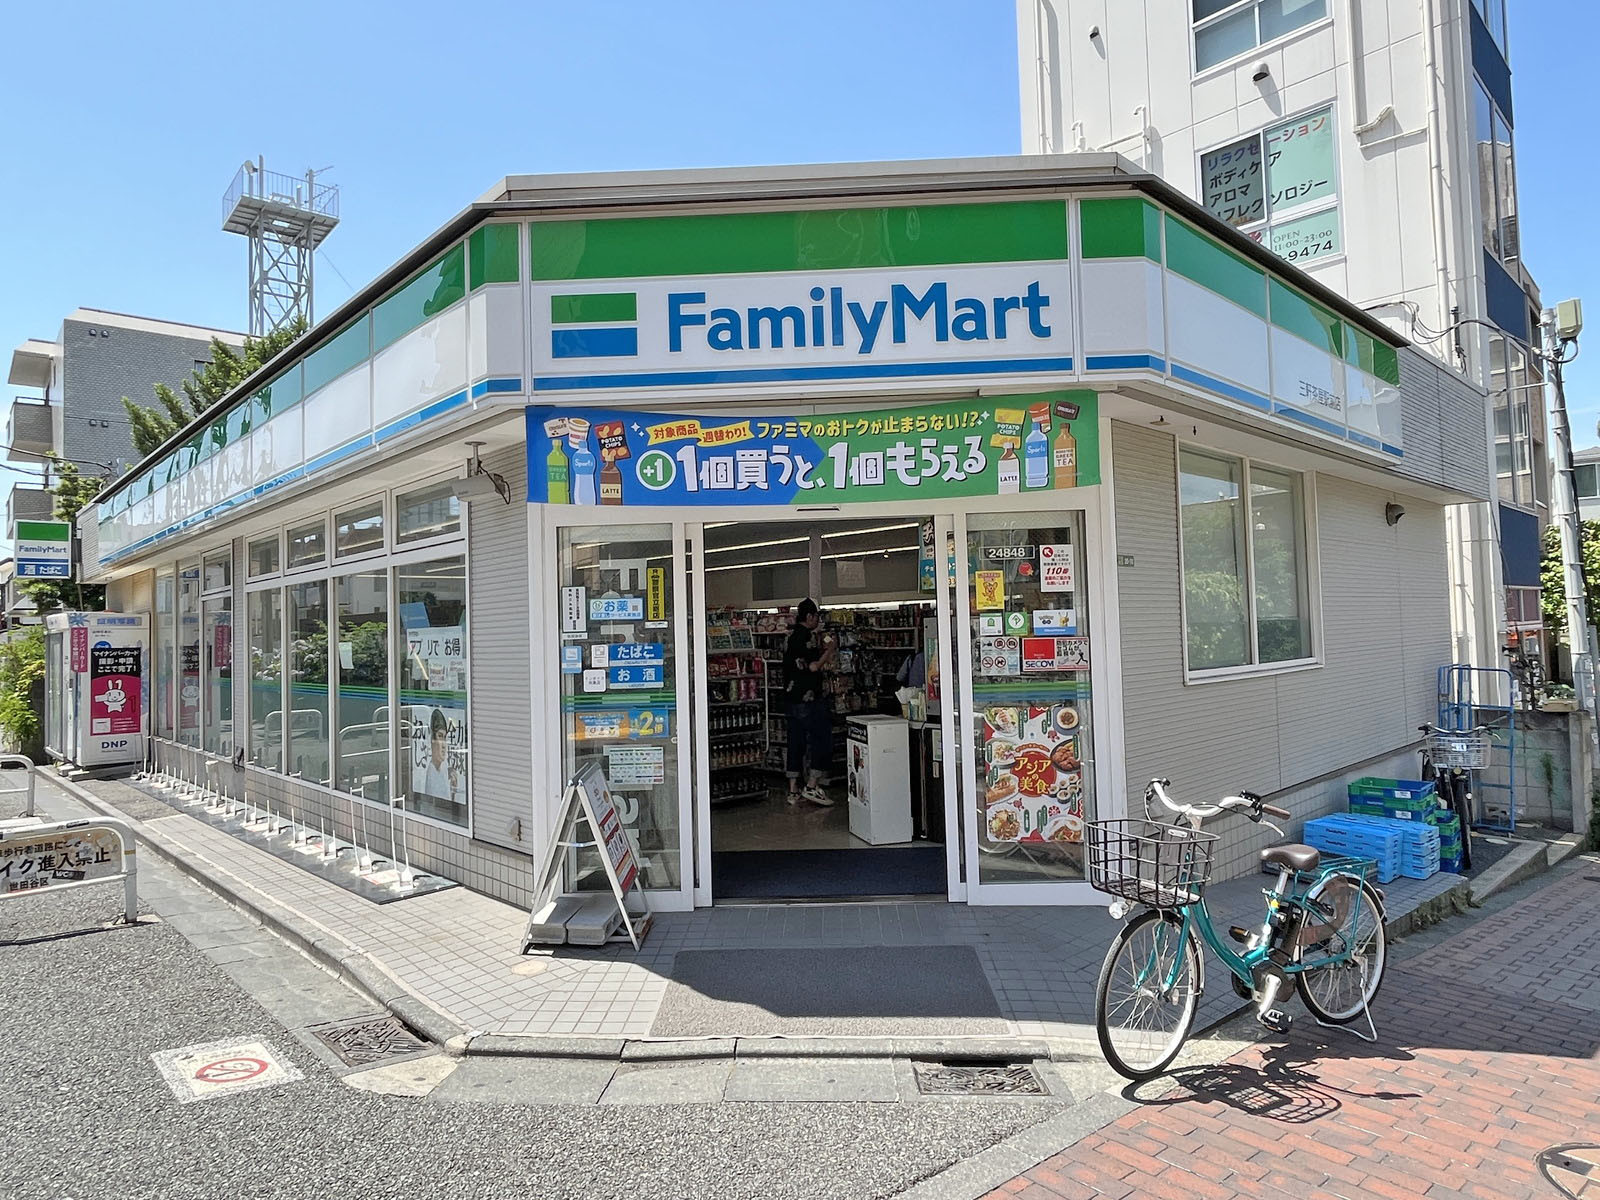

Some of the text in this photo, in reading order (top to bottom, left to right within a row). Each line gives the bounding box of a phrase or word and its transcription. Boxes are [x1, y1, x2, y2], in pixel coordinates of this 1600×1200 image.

[1208, 117, 1325, 171] リラクセーション
[1209, 150, 1281, 189] ボディケア
[1209, 183, 1250, 208] アロマ
[1273, 230, 1301, 244] OPEN
[1278, 240, 1333, 261] -9474
[668, 280, 1051, 354] FamilyMart
[653, 423, 699, 440] 対象商品
[757, 411, 979, 439] ファミマのおトクが止まらない!?
[997, 423, 1020, 431] POTATO
[999, 428, 1017, 436] CHIPS
[600, 436, 623, 445] POTATO
[701, 427, 747, 443] 週替わり!
[604, 441, 622, 449] CHIPS
[1056, 458, 1074, 466] TEA
[550, 472, 567, 481] TEA
[19, 545, 67, 554] FamilyMart
[989, 547, 1026, 558] 24848
[39, 565, 62, 575] たばこ
[604, 600, 629, 612] お薬
[444, 637, 461, 656] お得
[617, 645, 655, 659] たばこ
[1025, 660, 1054, 668] SECOM
[640, 711, 654, 736] 2
[101, 741, 128, 749] DNP
[1014, 757, 1051, 775] アジア
[1020, 776, 1049, 794] 美食
[9, 876, 49, 892] 世田谷区
